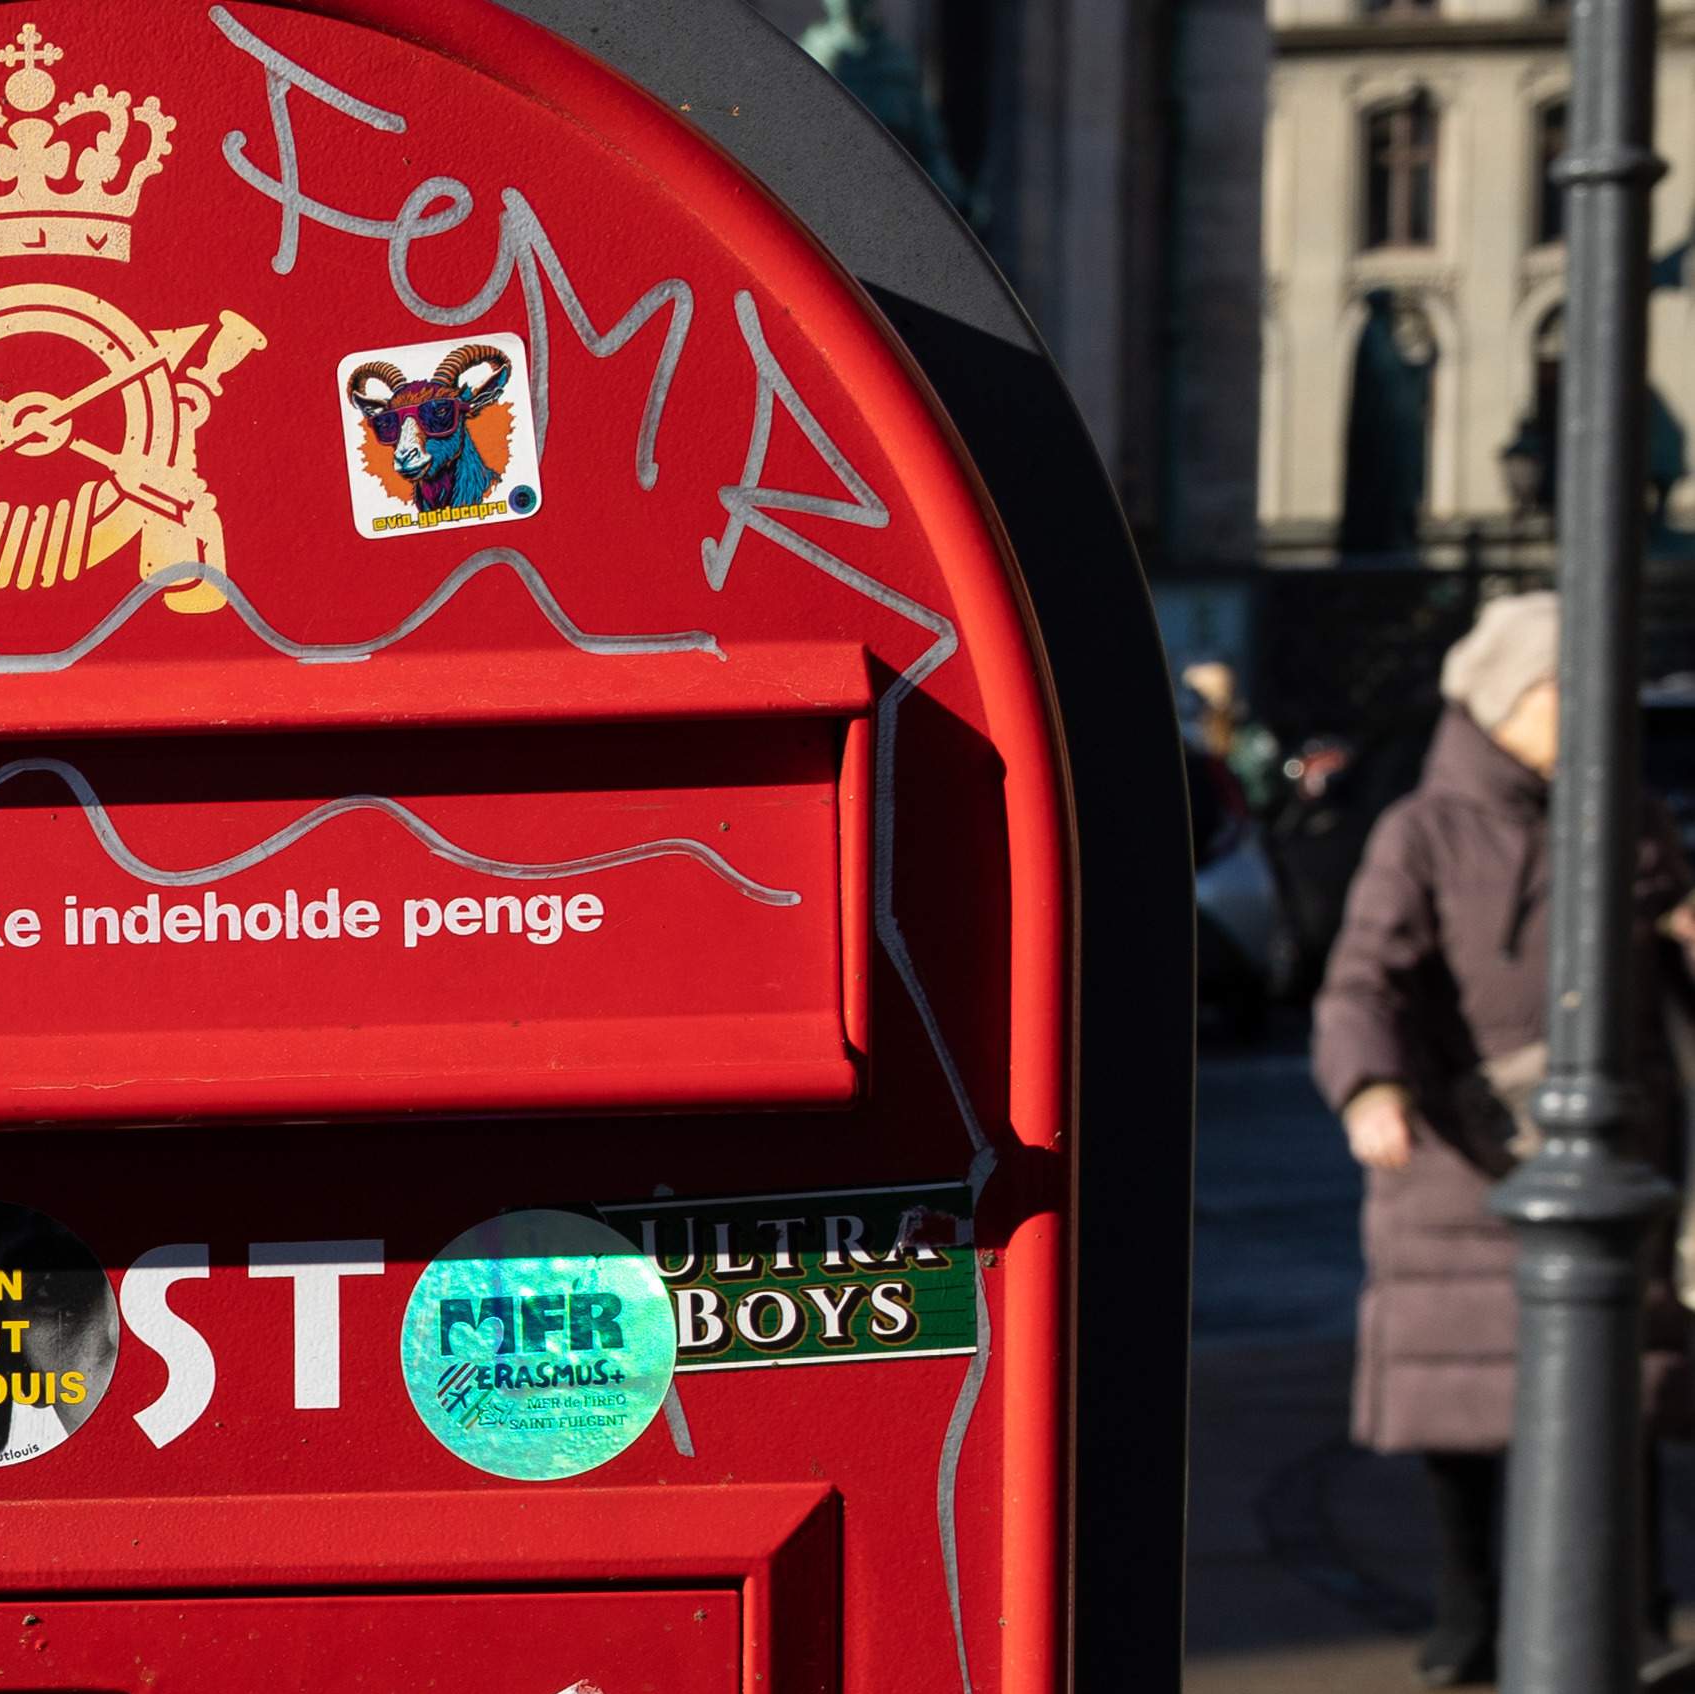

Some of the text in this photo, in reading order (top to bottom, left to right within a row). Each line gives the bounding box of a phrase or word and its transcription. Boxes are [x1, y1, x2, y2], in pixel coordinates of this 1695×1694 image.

[65, 888, 379, 946] indeholde
[403, 892, 603, 950] penge
[440, 1292, 624, 1357] MFR
[676, 1280, 917, 1354] BOYS
[476, 1359, 626, 1390] ERASMUS+
[510, 1417, 554, 1430] SAINT
